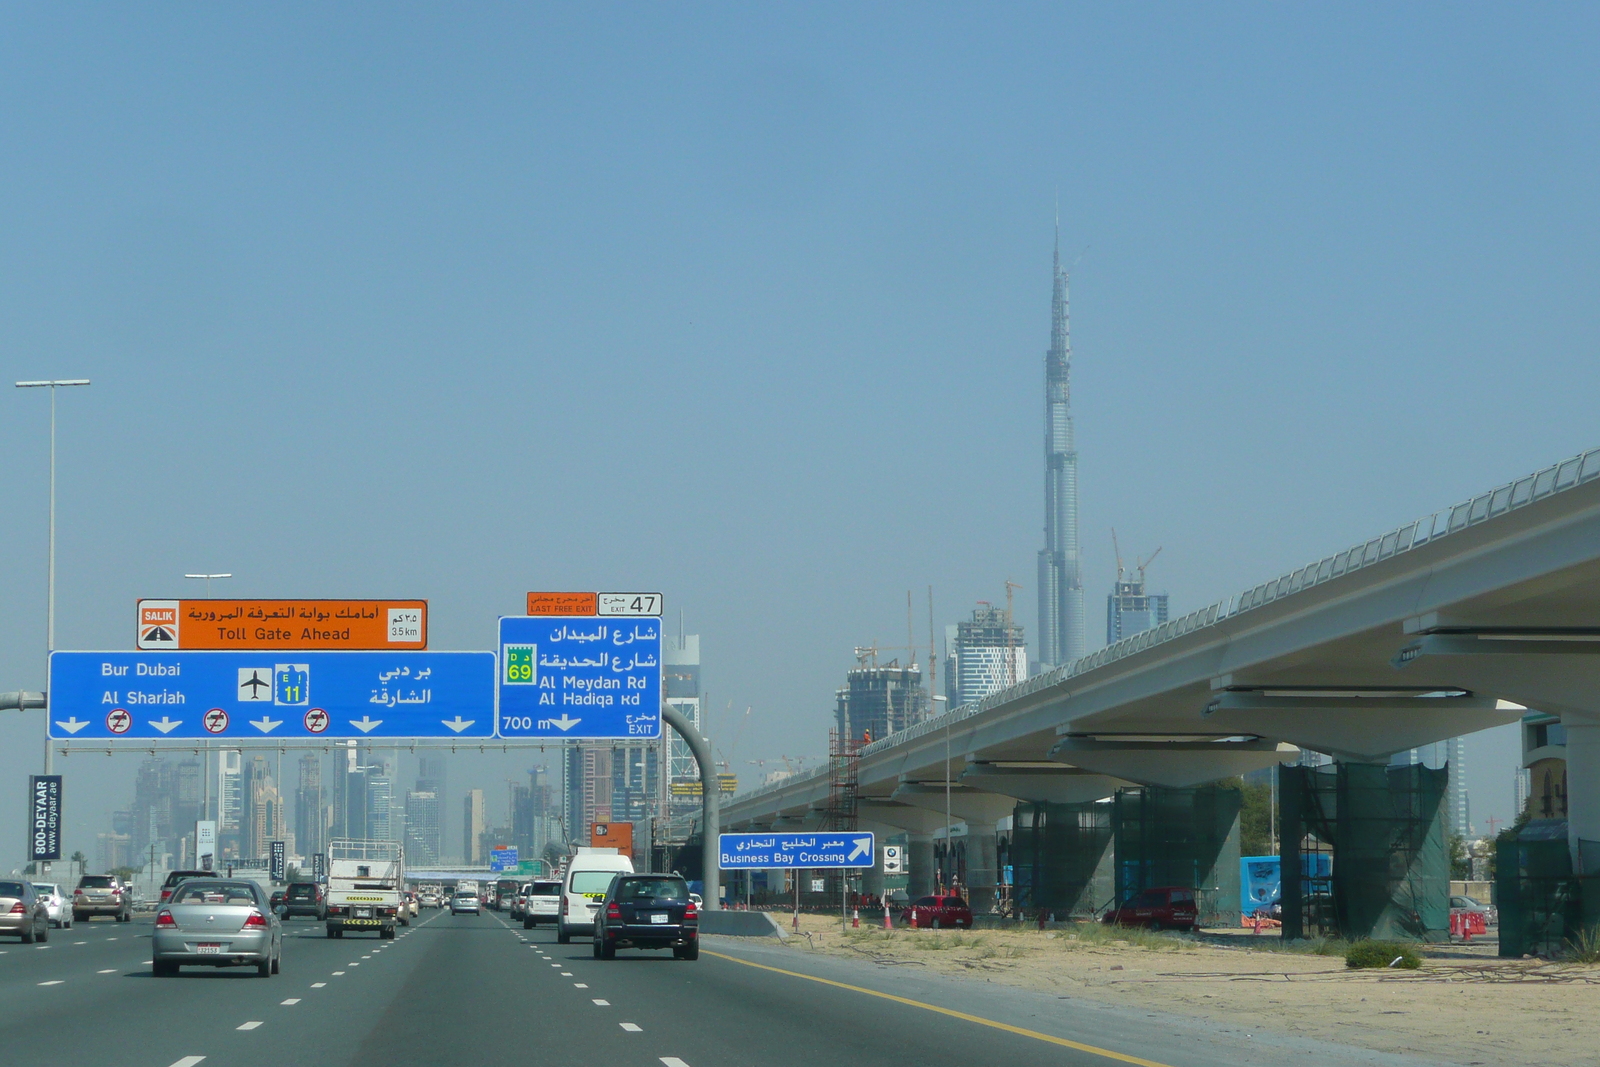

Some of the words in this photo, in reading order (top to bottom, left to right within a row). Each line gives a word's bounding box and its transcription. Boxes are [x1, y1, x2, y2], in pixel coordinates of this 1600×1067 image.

[603, 596, 625, 604] مخرج
[630, 597, 655, 612] 47
[145, 611, 172, 620] SALIK
[188, 607, 243, 621] المرورية
[247, 606, 295, 621] التعرفة
[299, 607, 330, 621] بوابة
[335, 605, 379, 619] أمامك
[393, 614, 403, 625] كم
[218, 628, 246, 640] Toll
[255, 628, 291, 640] Gate
[300, 628, 350, 640] Ahead
[405, 627, 417, 636] km
[550, 625, 607, 644] الميدان
[613, 625, 657, 646] شارع
[539, 652, 608, 670] الحديقة
[612, 652, 656, 672] شارع
[102, 663, 128, 676] Bur
[136, 663, 180, 676] Dubai
[379, 666, 410, 684] دبي
[414, 667, 431, 680] بر
[508, 665, 531, 679] 69
[283, 674, 289, 682] E
[539, 676, 556, 688] Al
[563, 676, 620, 691] Meydan
[627, 676, 646, 688] Rd
[102, 691, 118, 704] Al
[127, 689, 186, 704] Sharjah
[285, 686, 299, 701] 11
[370, 688, 431, 707] الشارقة
[539, 692, 555, 705] Al
[563, 692, 613, 708] Hadiqa
[502, 717, 531, 729] 700
[538, 720, 550, 729] m
[626, 713, 656, 724] مخرج
[629, 725, 653, 734] EXIT
[35, 782, 47, 854] 800-DEYAAR
[48, 782, 58, 853] www.deyaar.ae
[736, 839, 775, 851] التجاري
[781, 839, 816, 850] الخليج
[822, 840, 845, 850] معبر
[722, 854, 769, 863] Business
[774, 853, 794, 864] Bay
[800, 853, 845, 864] Crossing
